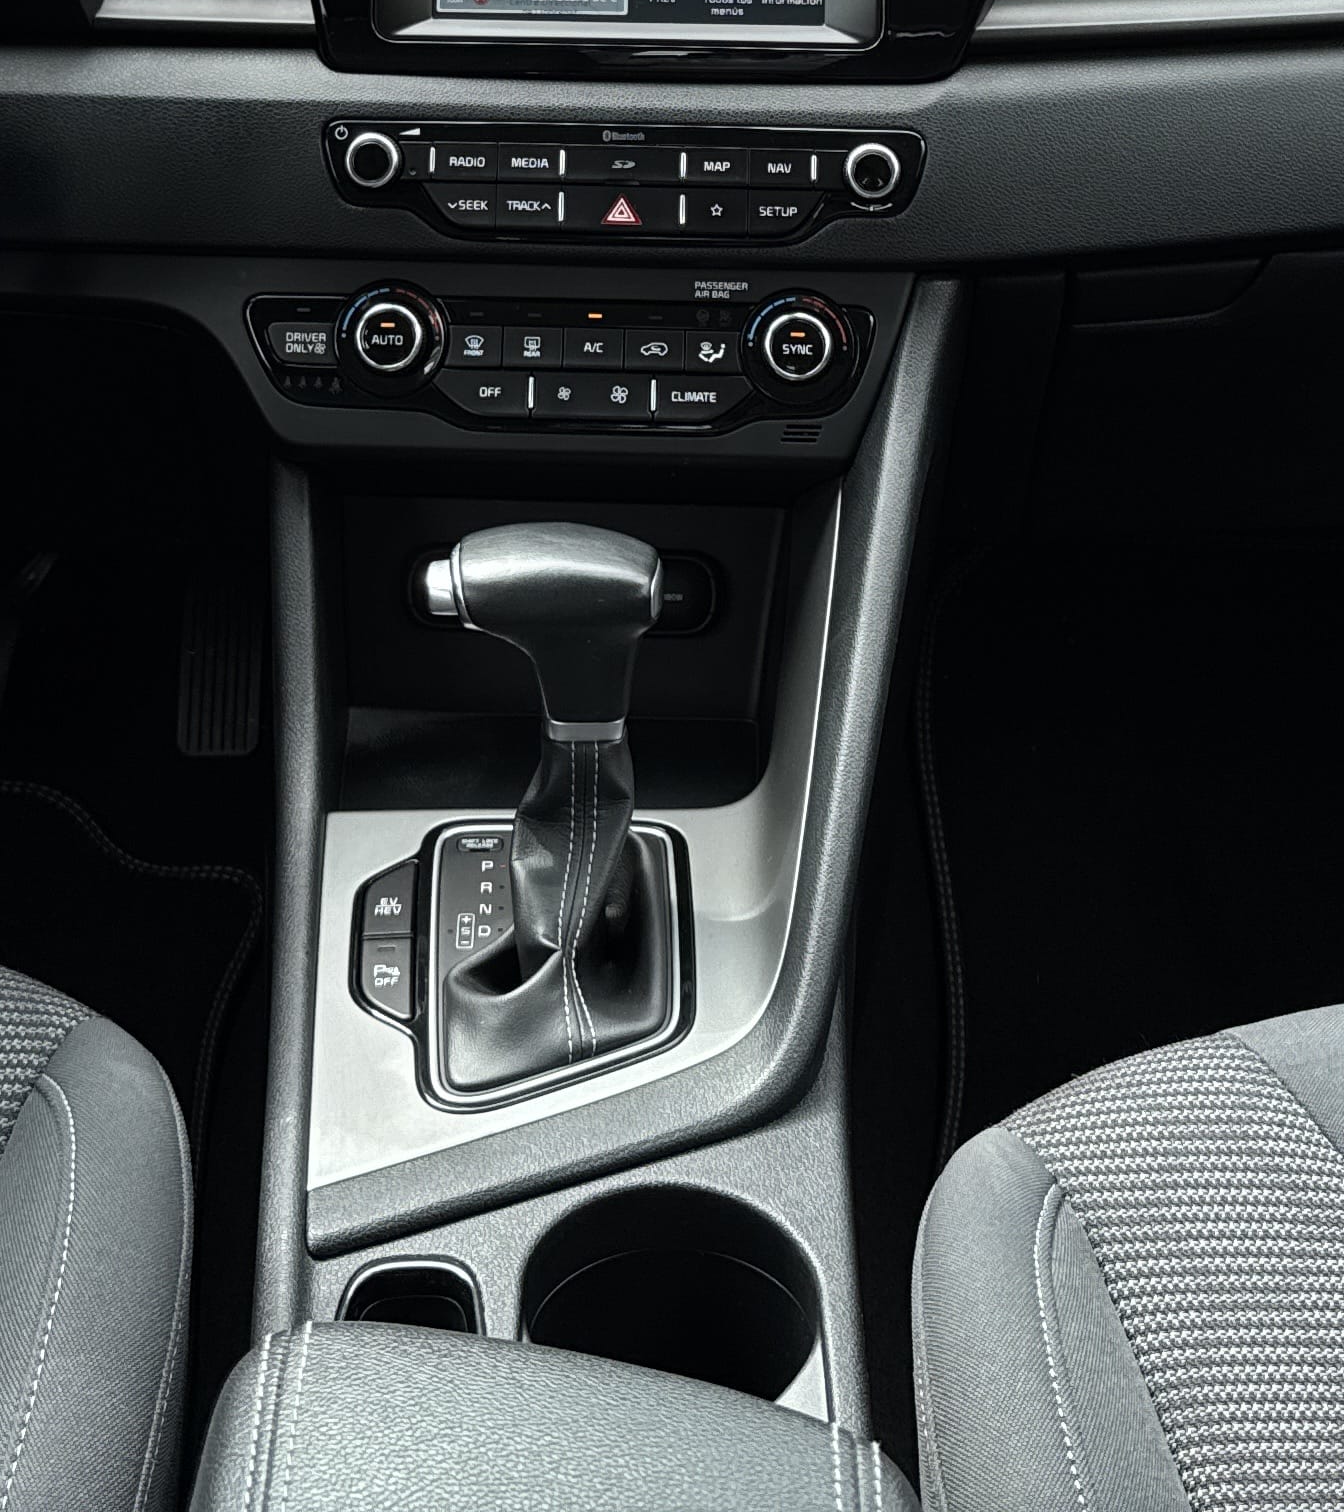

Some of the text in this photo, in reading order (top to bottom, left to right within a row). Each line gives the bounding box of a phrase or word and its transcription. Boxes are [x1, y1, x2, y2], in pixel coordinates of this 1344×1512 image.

[711, 6, 744, 16] menús
[449, 156, 486, 168] RADIO
[511, 157, 549, 169] MEDIA
[703, 161, 731, 173] MAP
[767, 162, 792, 174] NAV
[458, 199, 489, 211] SEEK
[506, 200, 541, 211] TRACK
[758, 206, 798, 218] SETUP
[694, 281, 749, 292] PASSENGER
[694, 290, 730, 299] AIR BAG
[285, 332, 327, 343] DRIVER
[371, 335, 404, 346] AUTO
[285, 342, 314, 353] ONLY
[583, 342, 604, 354] A/C
[782, 344, 813, 356] SYNC
[479, 386, 502, 398] OFF
[671, 390, 717, 403] CLIMATE
[481, 860, 494, 873] P
[480, 881, 493, 894] R
[380, 897, 399, 906] EV
[479, 903, 492, 915] N
[478, 925, 492, 938] D
[374, 977, 400, 988] OFF
